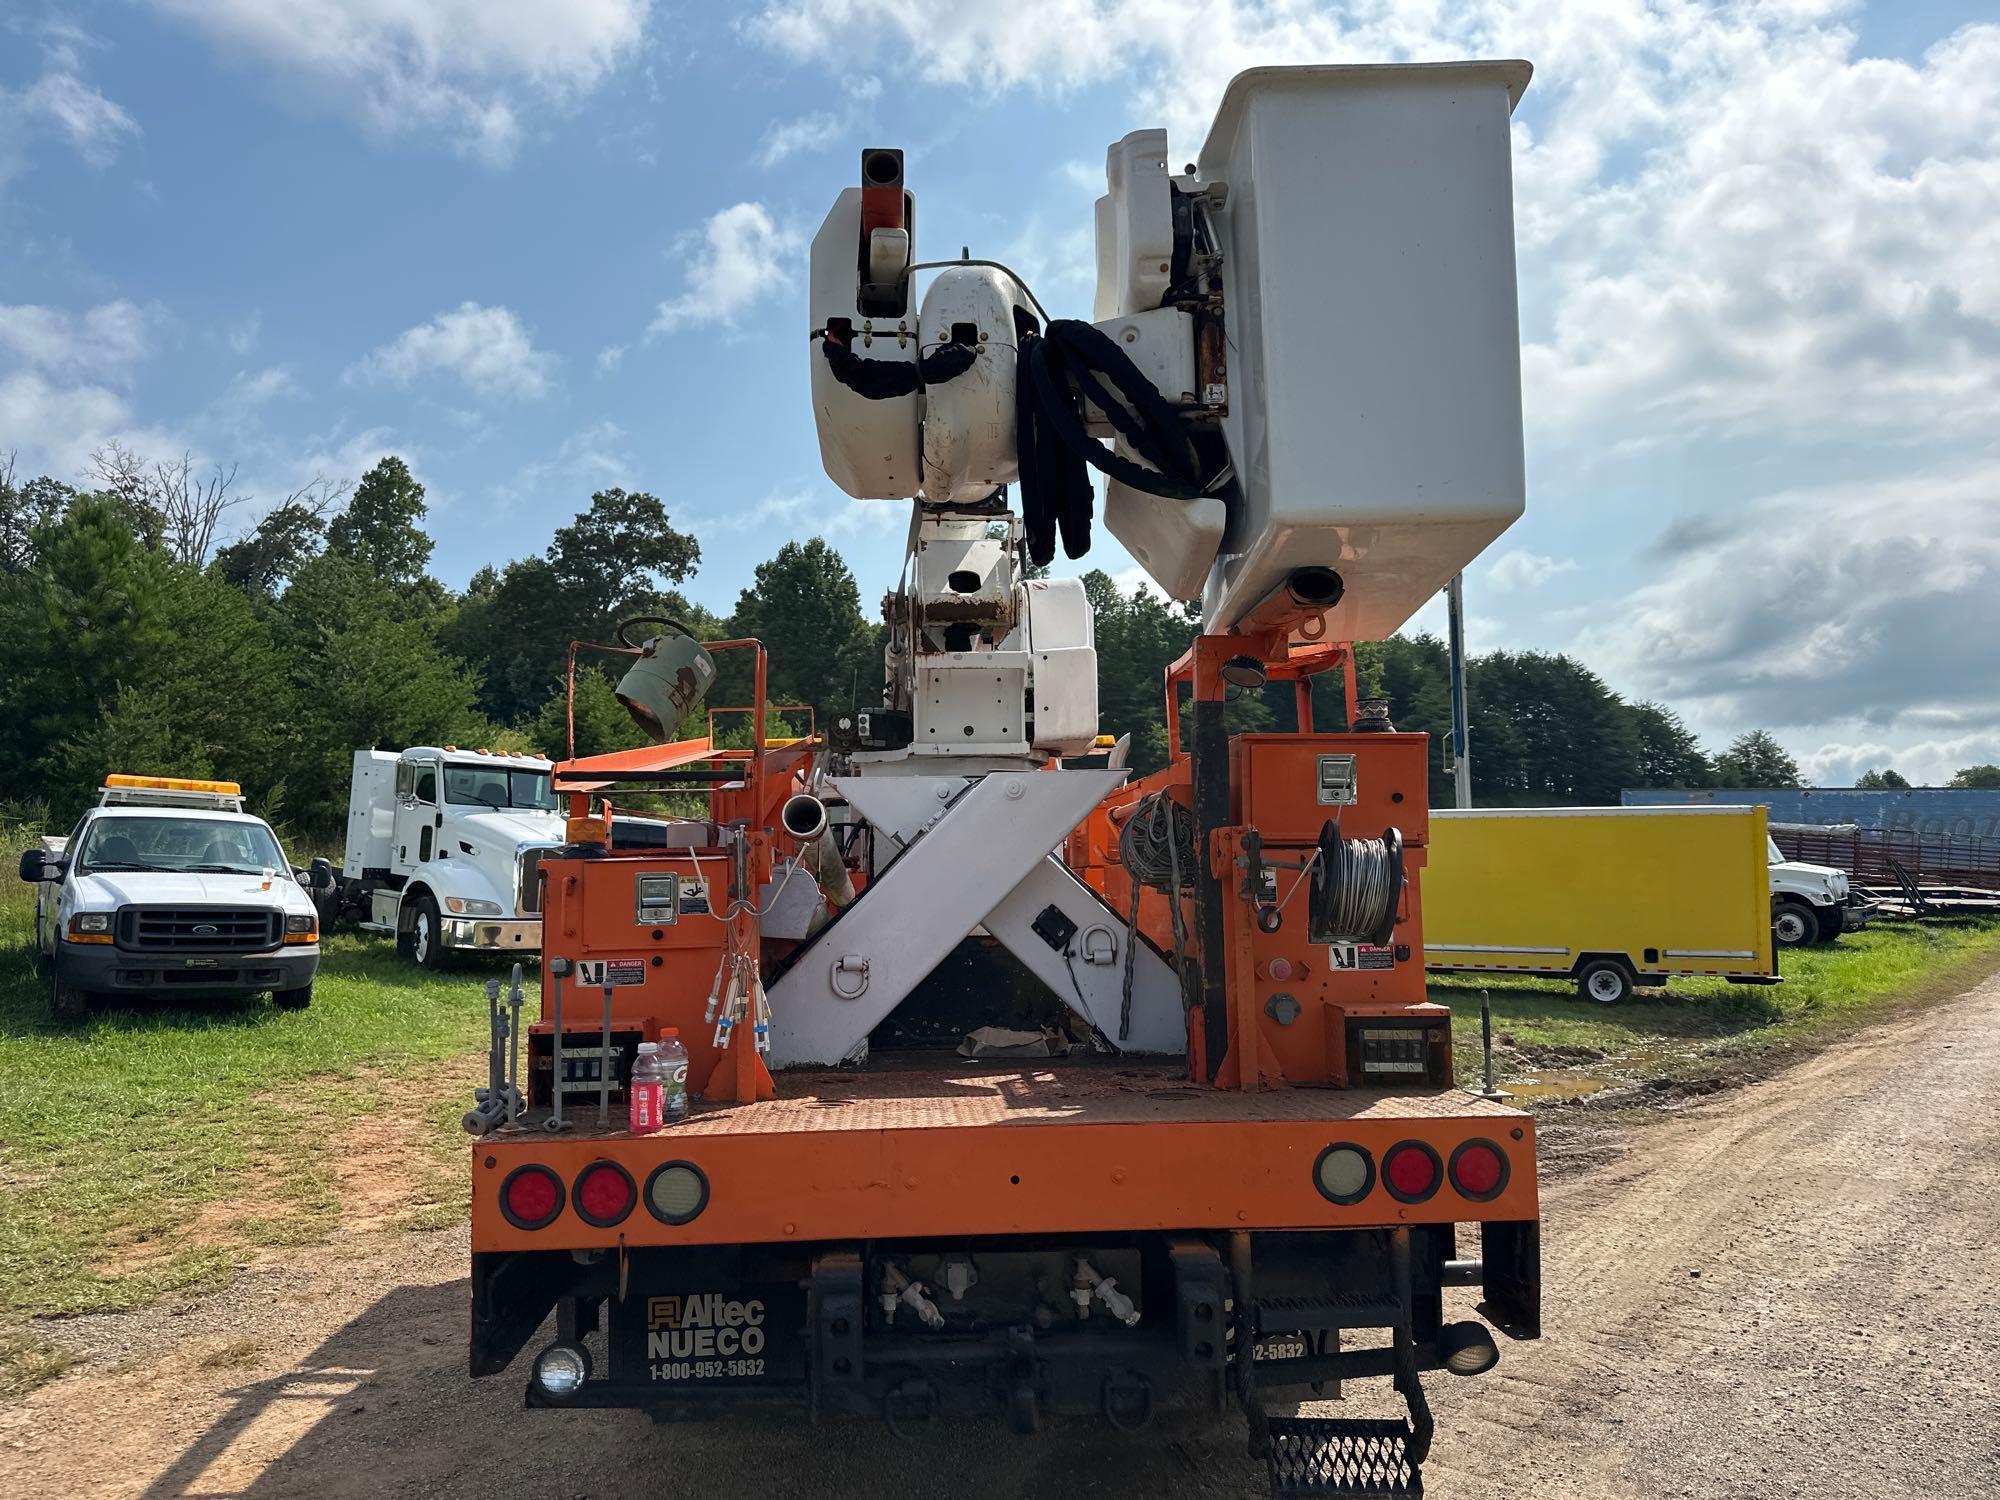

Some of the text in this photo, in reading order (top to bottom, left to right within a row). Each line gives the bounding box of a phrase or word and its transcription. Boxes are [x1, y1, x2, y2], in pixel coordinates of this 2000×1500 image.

[681, 1293, 765, 1329] Altec
[647, 1326, 765, 1359] NUECO
[649, 1358, 765, 1381] 1-800-952-5832
